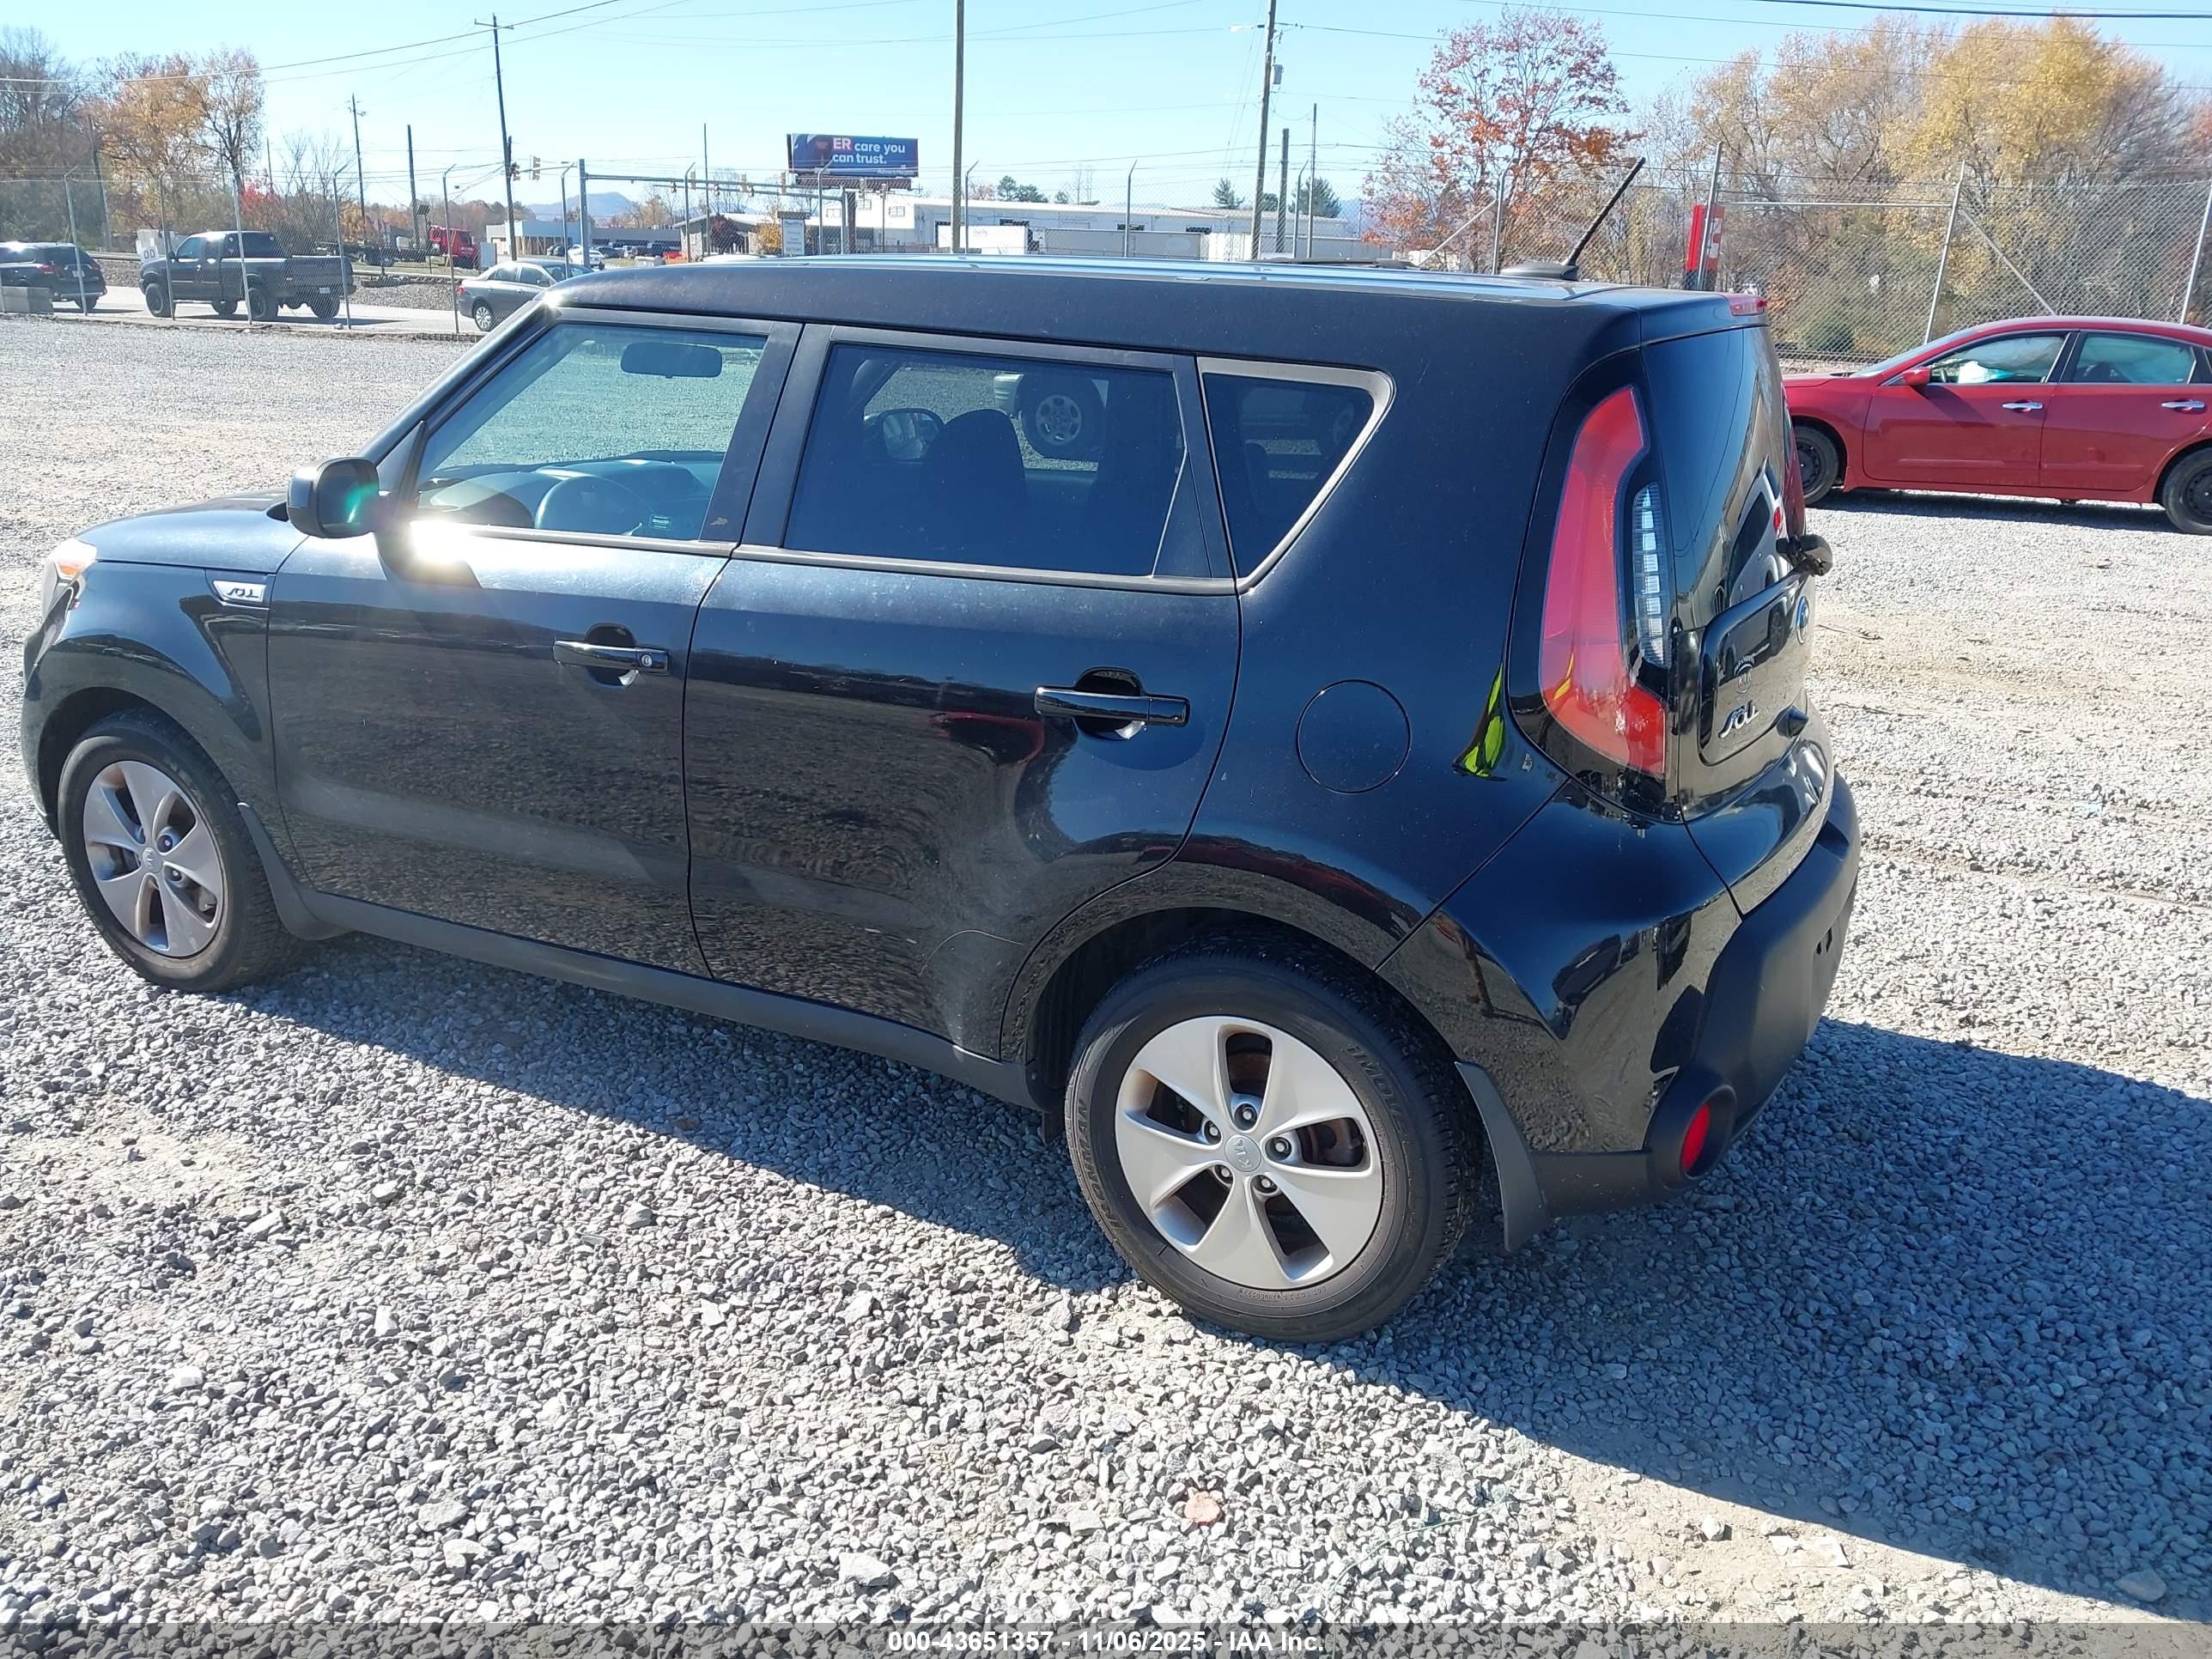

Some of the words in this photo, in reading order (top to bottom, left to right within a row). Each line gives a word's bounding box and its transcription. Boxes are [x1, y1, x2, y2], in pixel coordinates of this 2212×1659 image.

[833, 137, 851, 149] ER
[854, 143, 880, 152] care
[884, 143, 906, 155] you
[832, 153, 854, 163] can
[856, 154, 887, 164] trust.
[1232, 1138, 1253, 1169] KIA
